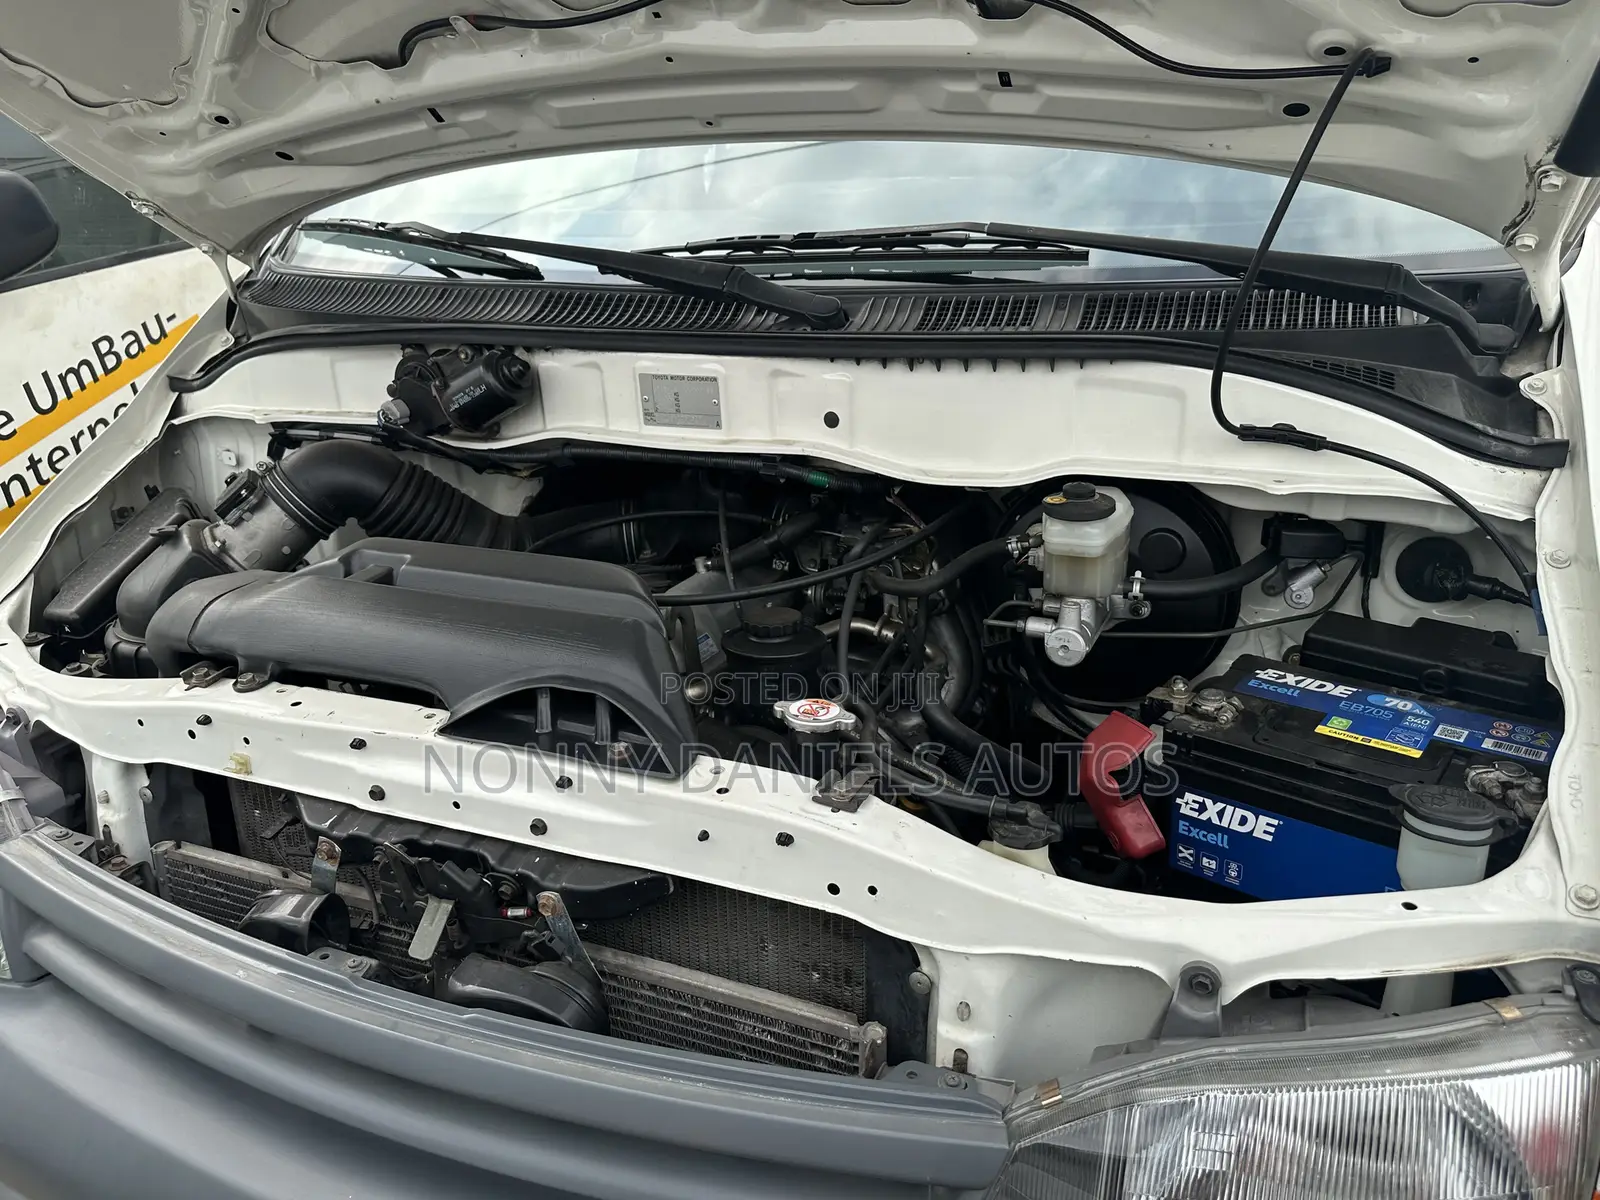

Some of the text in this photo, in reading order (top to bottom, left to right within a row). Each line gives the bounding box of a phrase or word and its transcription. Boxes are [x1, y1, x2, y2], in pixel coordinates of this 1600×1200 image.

[22, 312, 177, 416] UmBau-
[1247, 679, 1301, 698] Excell
[1254, 668, 1359, 698] EXIDE
[1339, 700, 1395, 719] EB705
[1384, 697, 1413, 712] 70
[1406, 715, 1430, 726] 540
[1328, 729, 1360, 741] CAUTION
[1175, 791, 1280, 842] EXIDE
[1177, 819, 1230, 850] Excell
